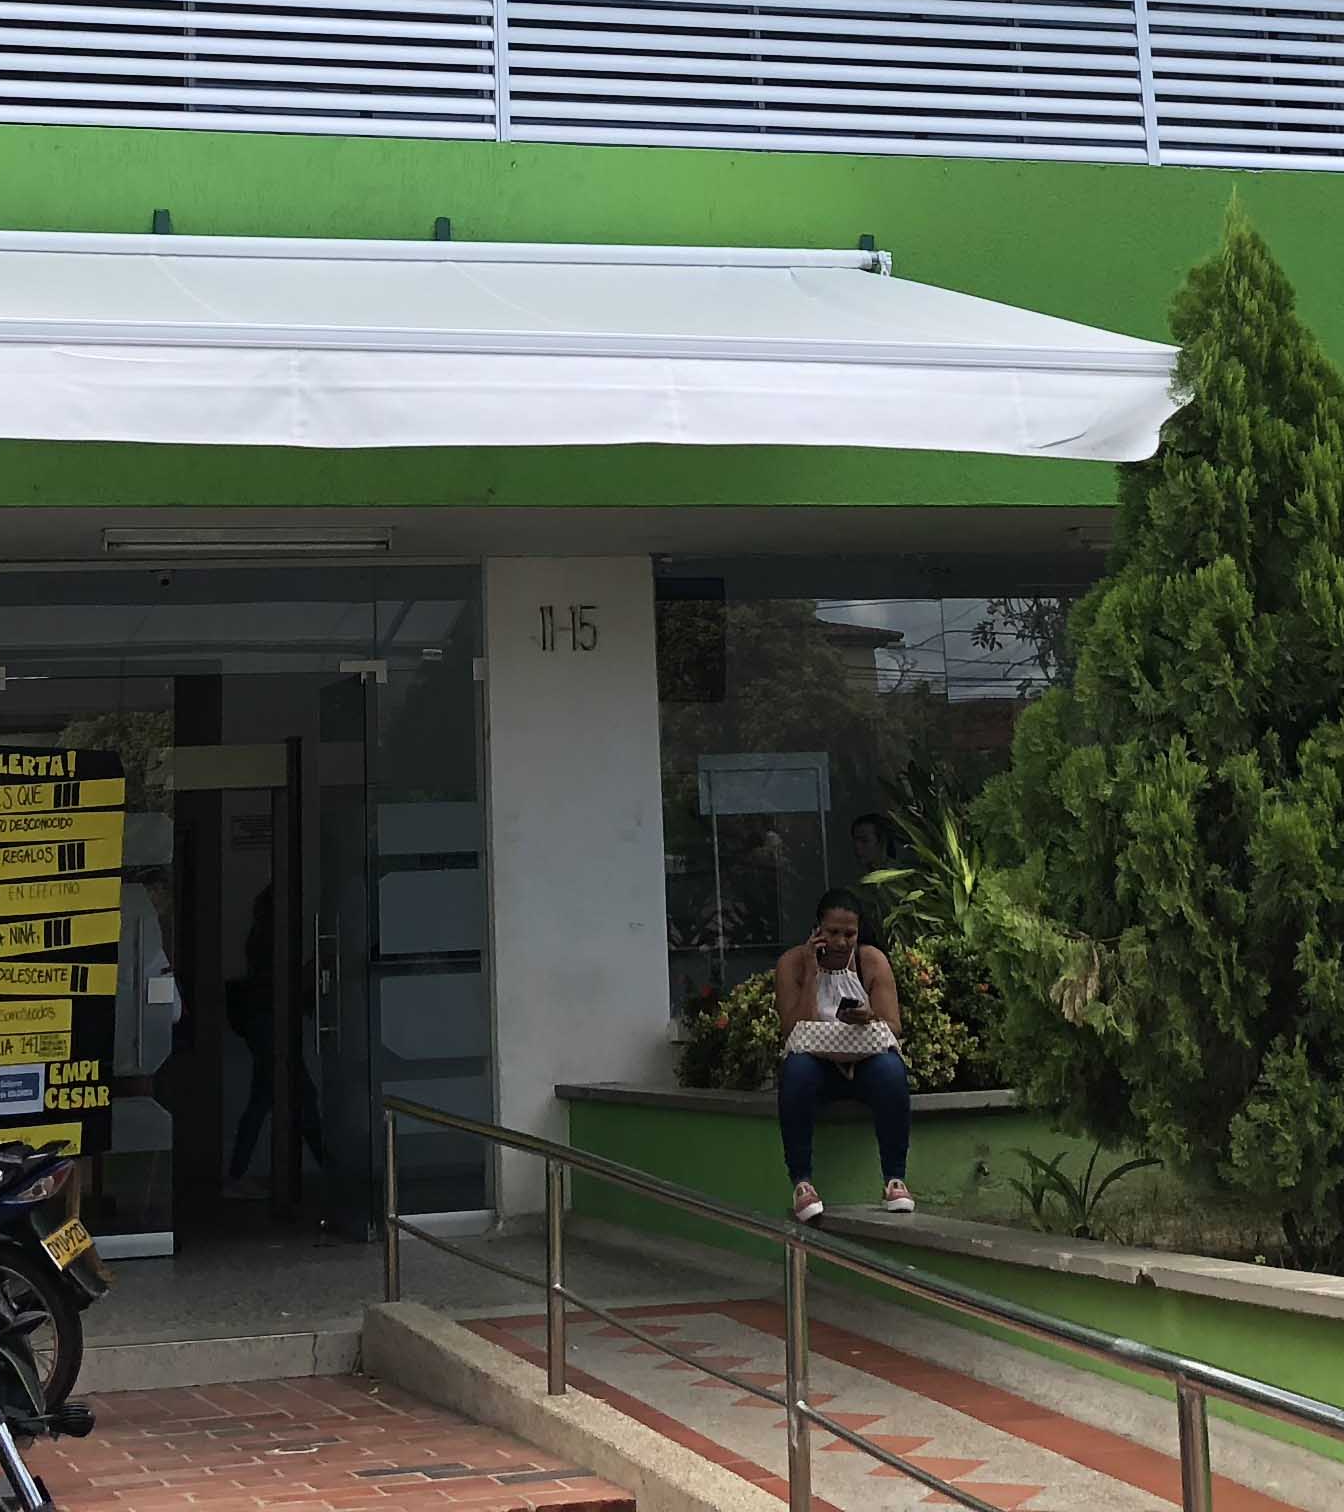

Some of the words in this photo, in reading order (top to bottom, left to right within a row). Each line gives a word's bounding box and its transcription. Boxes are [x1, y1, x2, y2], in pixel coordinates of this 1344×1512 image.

[539, 605, 598, 651] 11-15
[17, 785, 44, 806] QUE
[2, 847, 55, 865] REGALOS
[49, 1060, 100, 1085] EMPI
[44, 1086, 110, 1109] CESAR
